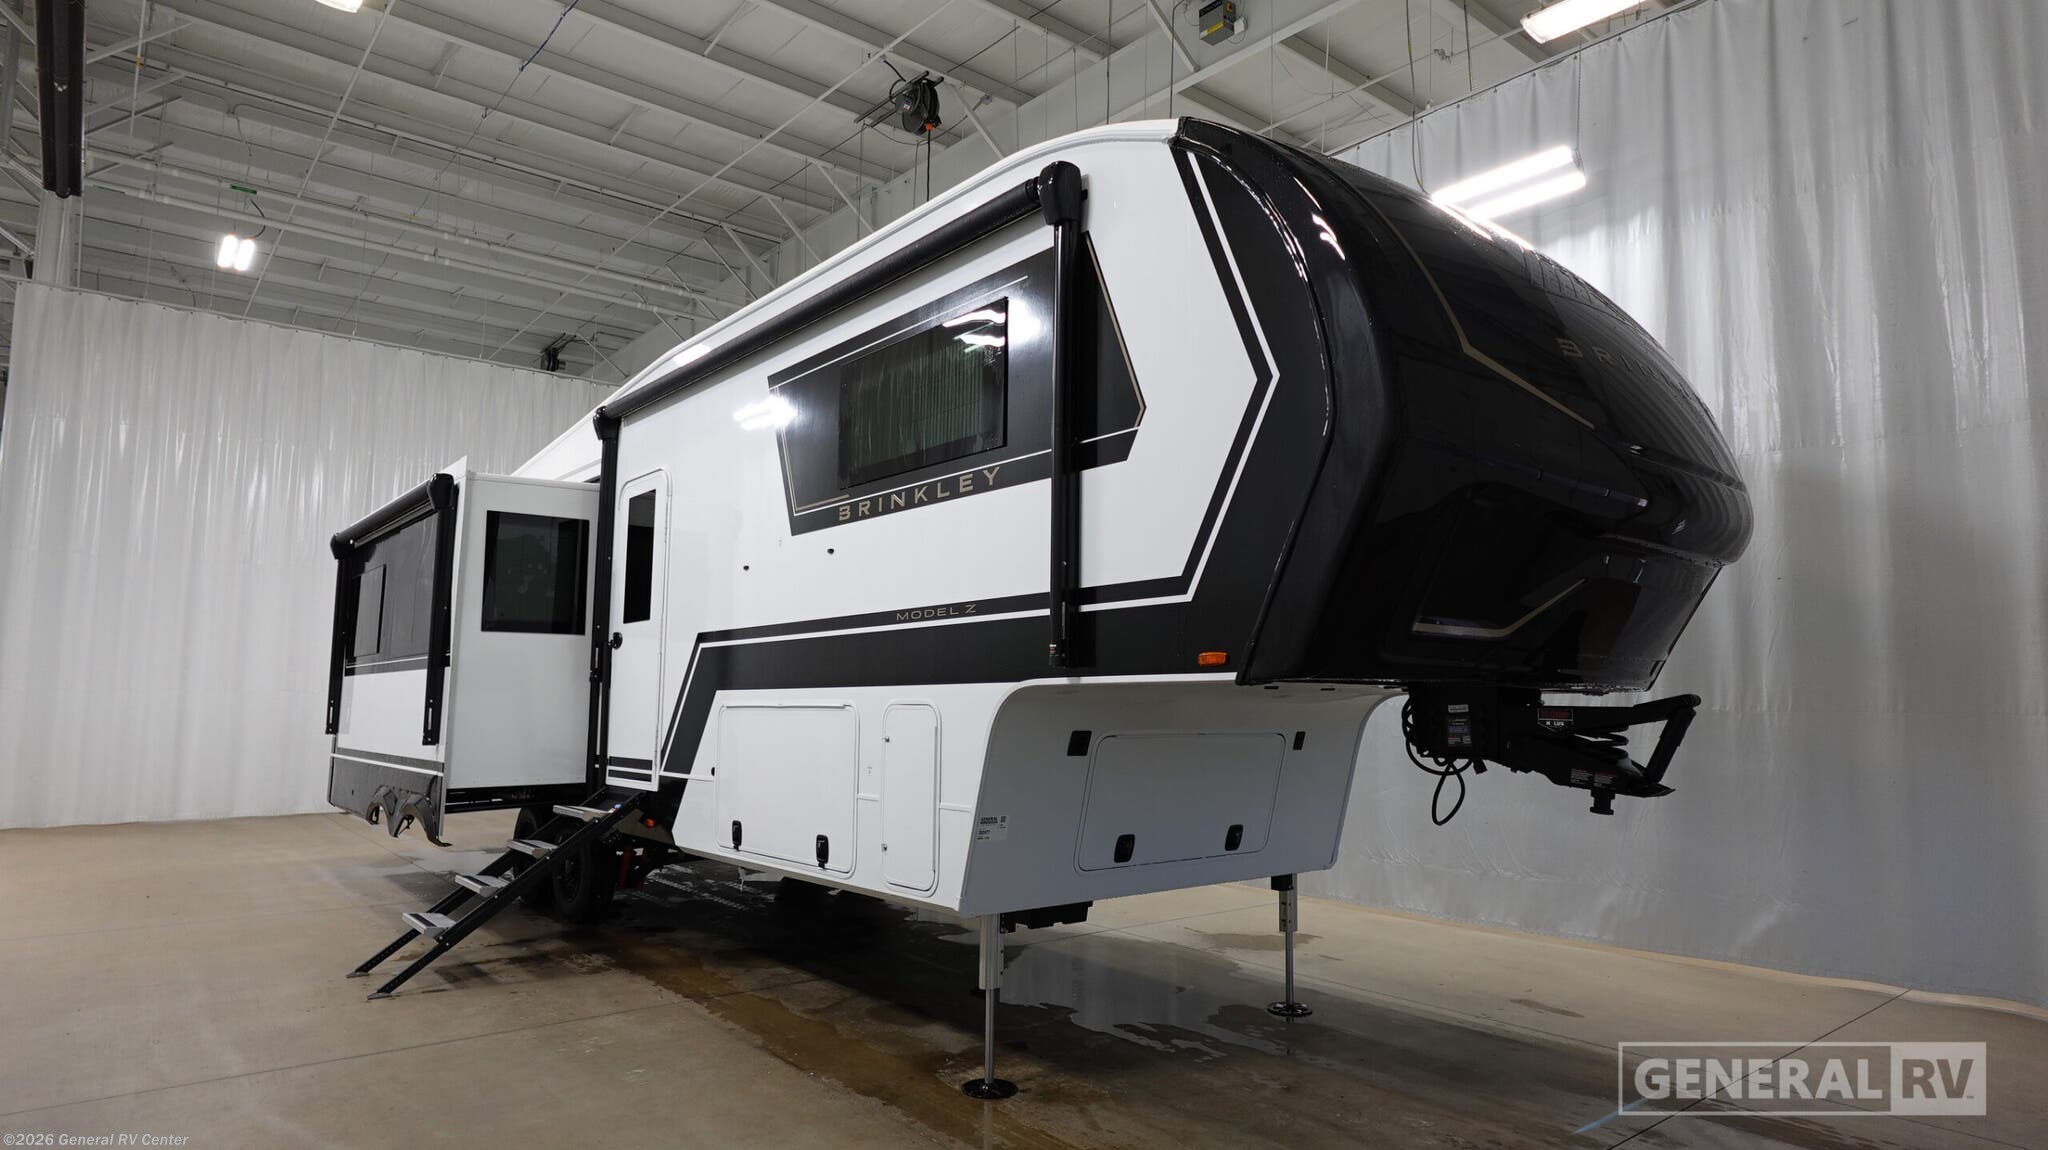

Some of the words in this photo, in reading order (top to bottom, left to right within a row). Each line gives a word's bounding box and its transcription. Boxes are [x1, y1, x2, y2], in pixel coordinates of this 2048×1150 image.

[838, 466, 1000, 521] BRINKLEY
[896, 607, 960, 621] MODEL
[965, 603, 977, 613] Z
